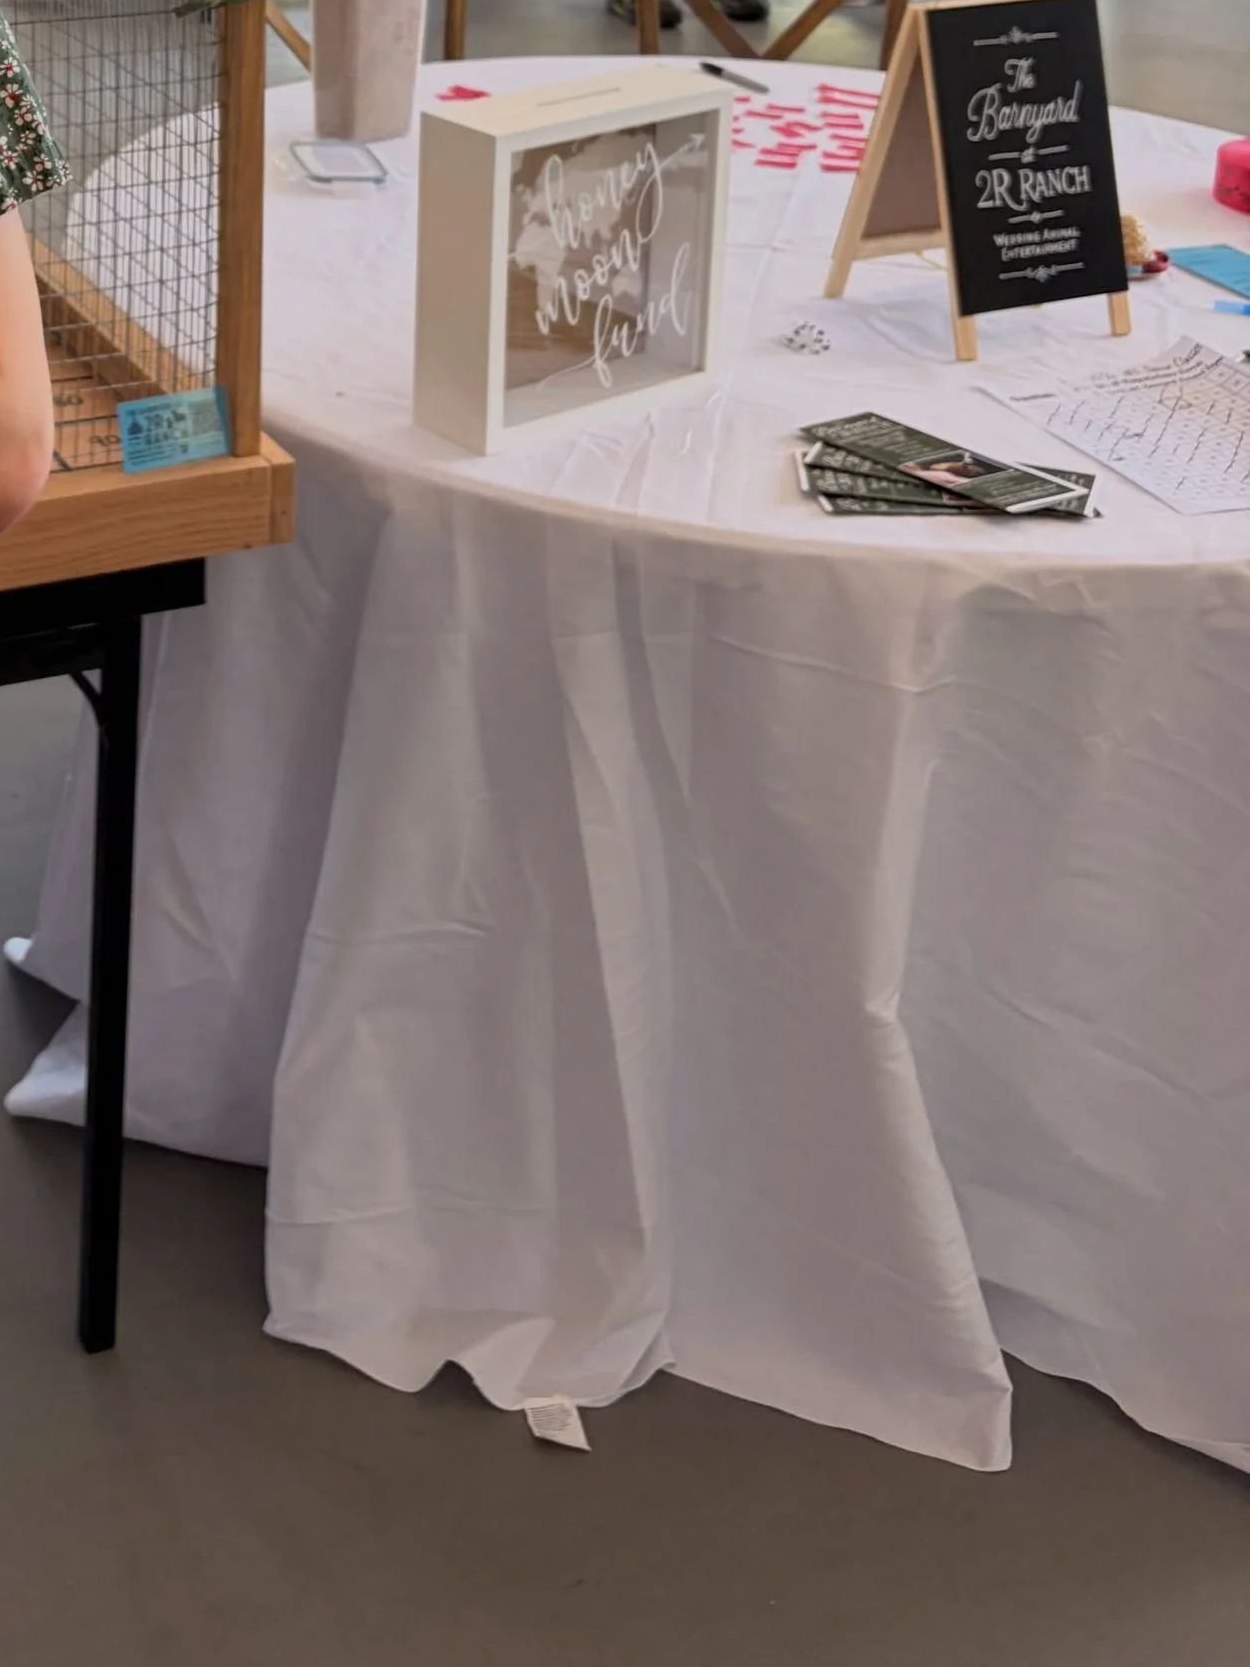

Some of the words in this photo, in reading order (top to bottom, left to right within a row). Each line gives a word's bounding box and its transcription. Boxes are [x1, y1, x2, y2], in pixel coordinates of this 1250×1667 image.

[1004, 57, 1037, 93] The
[966, 78, 1084, 144] Barnyard
[546, 142, 664, 249] honey
[975, 167, 1031, 211] 2R
[1017, 165, 1091, 203] RANCH
[535, 229, 644, 335] moon
[594, 241, 690, 388] fund
[90, 434, 122, 446] 90
